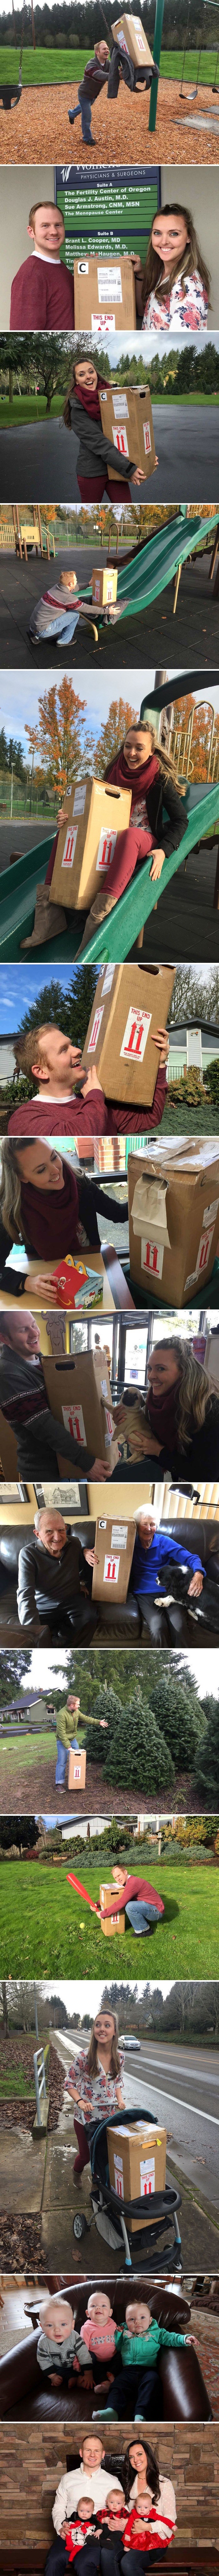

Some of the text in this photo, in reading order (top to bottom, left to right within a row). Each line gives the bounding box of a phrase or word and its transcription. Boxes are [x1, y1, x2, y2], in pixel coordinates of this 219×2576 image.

[79, 263, 86, 272] C
[100, 967, 104, 975] C
[128, 1162, 135, 1173] C
[200, 1175, 207, 1187] C
